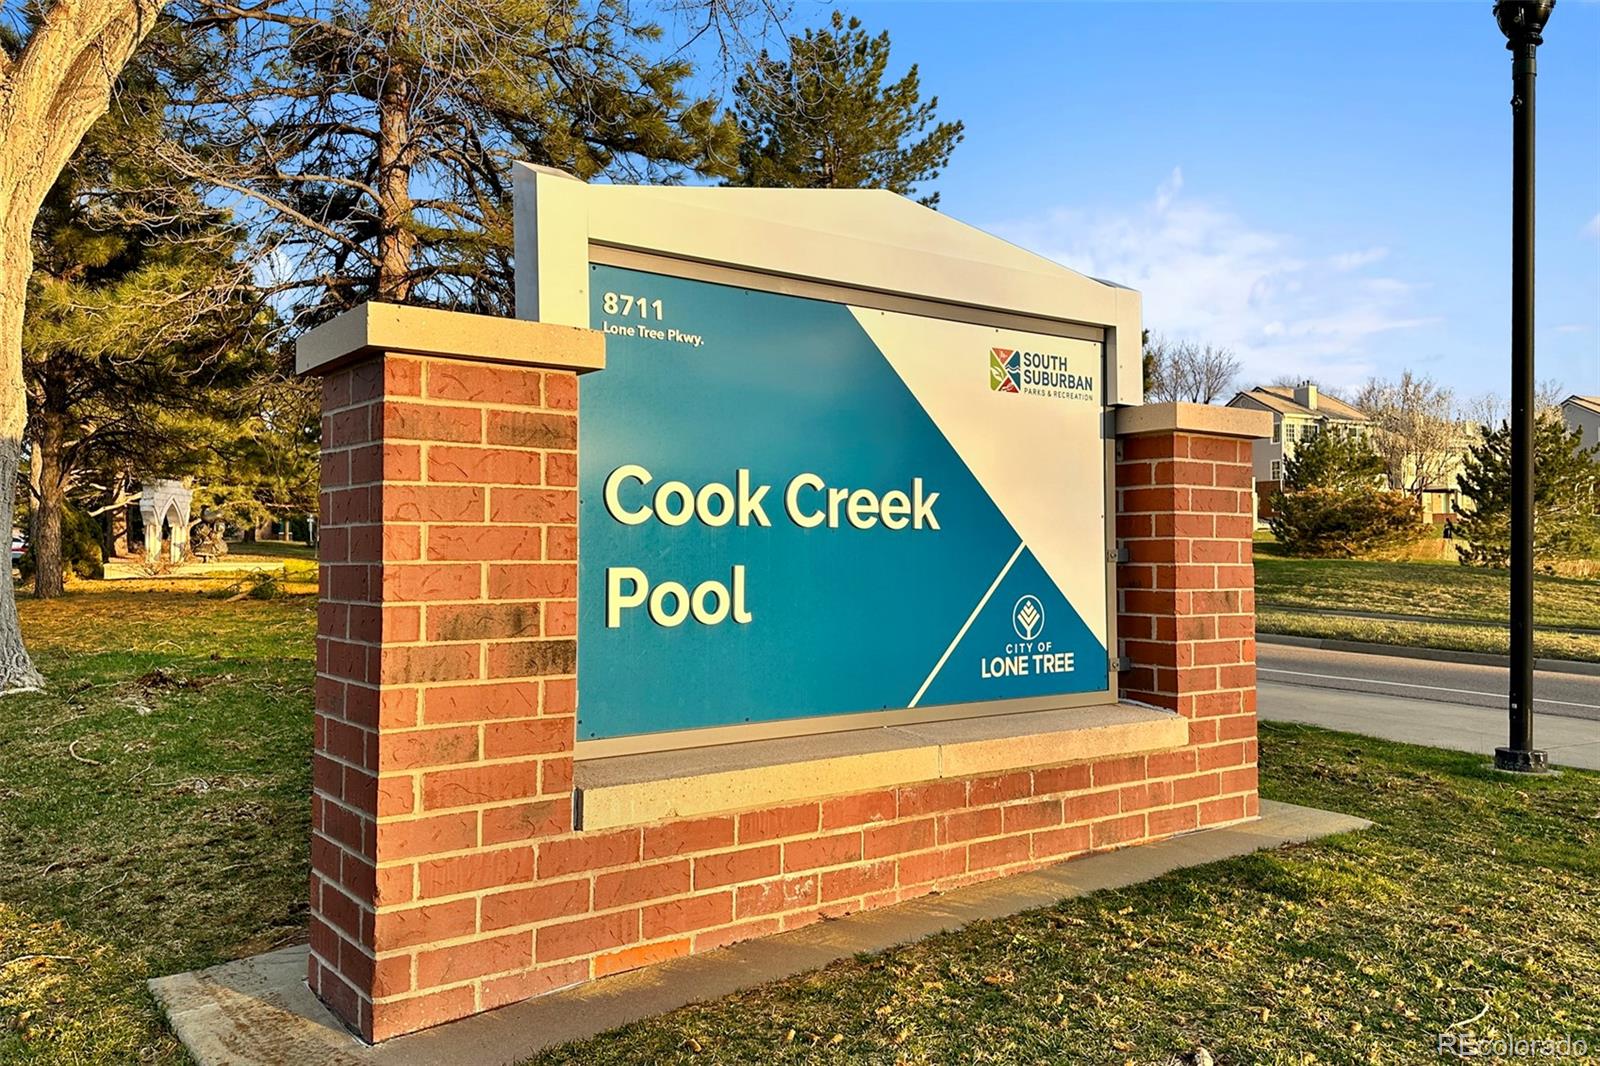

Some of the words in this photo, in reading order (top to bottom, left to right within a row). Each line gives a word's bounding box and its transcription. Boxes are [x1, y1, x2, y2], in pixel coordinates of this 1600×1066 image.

[603, 292, 663, 320] 8711
[603, 321, 635, 336] Lone
[638, 325, 665, 340] Tree
[667, 329, 705, 347] Pkwy.
[1023, 352, 1067, 371] SOUTH
[1023, 370, 1093, 391] SUBURBAN
[1024, 388, 1045, 397] PARKS
[1053, 391, 1093, 401] RECREATION
[603, 464, 772, 527] Cook
[785, 473, 941, 530] Creek
[606, 565, 752, 628] Pool
[1005, 643, 1033, 654] CITY
[1037, 642, 1052, 652] OF
[981, 655, 1029, 678] LONE
[1032, 652, 1075, 674] TREE
